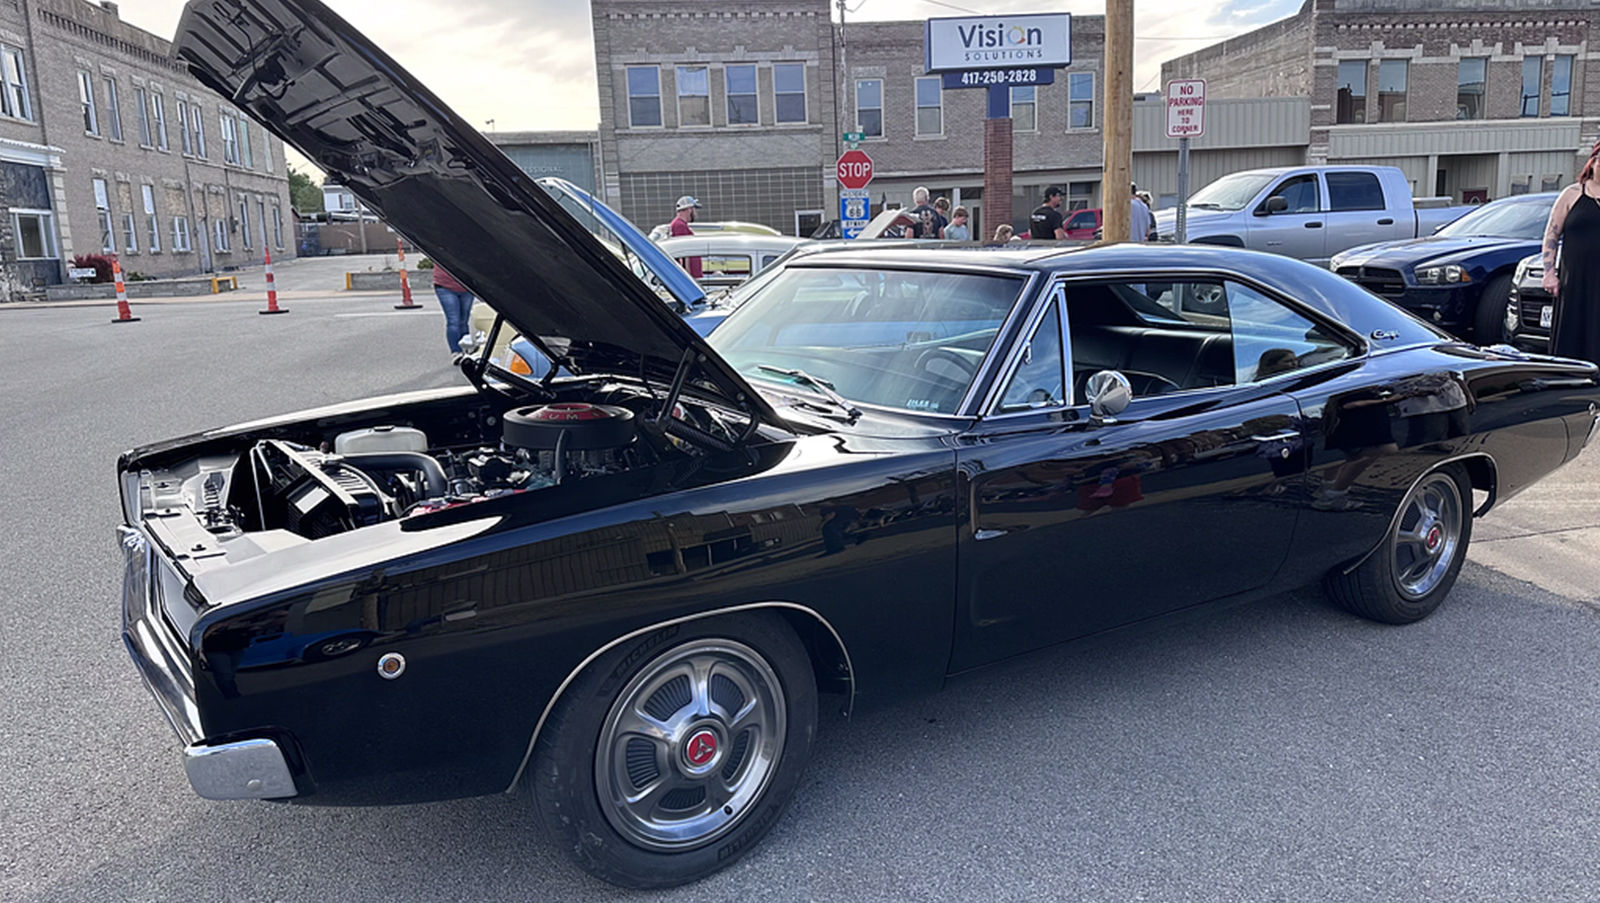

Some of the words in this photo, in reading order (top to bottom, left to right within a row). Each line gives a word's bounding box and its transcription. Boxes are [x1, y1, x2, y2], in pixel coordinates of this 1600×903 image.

[958, 23, 1042, 48] Vision
[965, 50, 1042, 61] SOLUTIONS
[961, 69, 1036, 85] 417-250-2828
[1180, 85, 1194, 95] NO
[1169, 96, 1203, 107] PARKING
[1172, 125, 1199, 133] CORNER
[839, 162, 871, 178] STOP
[849, 206, 862, 218] 66
